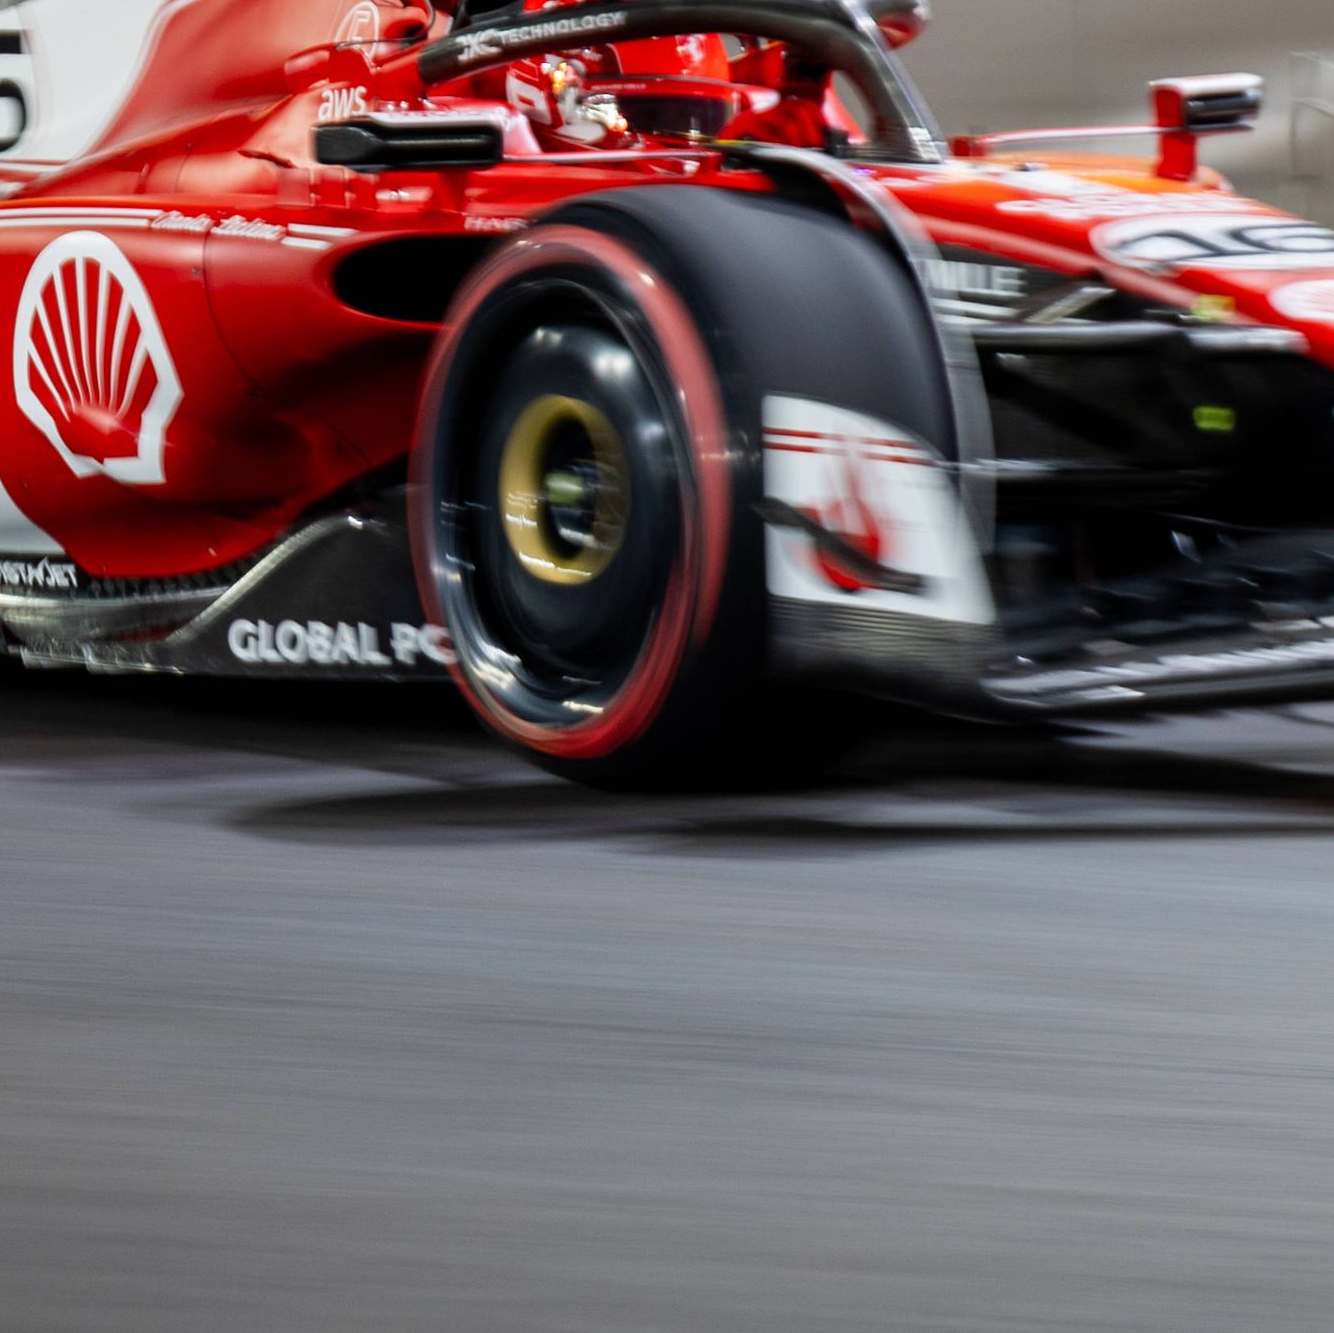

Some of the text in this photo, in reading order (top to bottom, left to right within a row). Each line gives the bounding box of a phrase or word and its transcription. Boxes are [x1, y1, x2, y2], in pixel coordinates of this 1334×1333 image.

[500, 11, 629, 44] TECHNOLOGY
[318, 85, 368, 123] aws
[227, 618, 392, 665] GLOBAL
